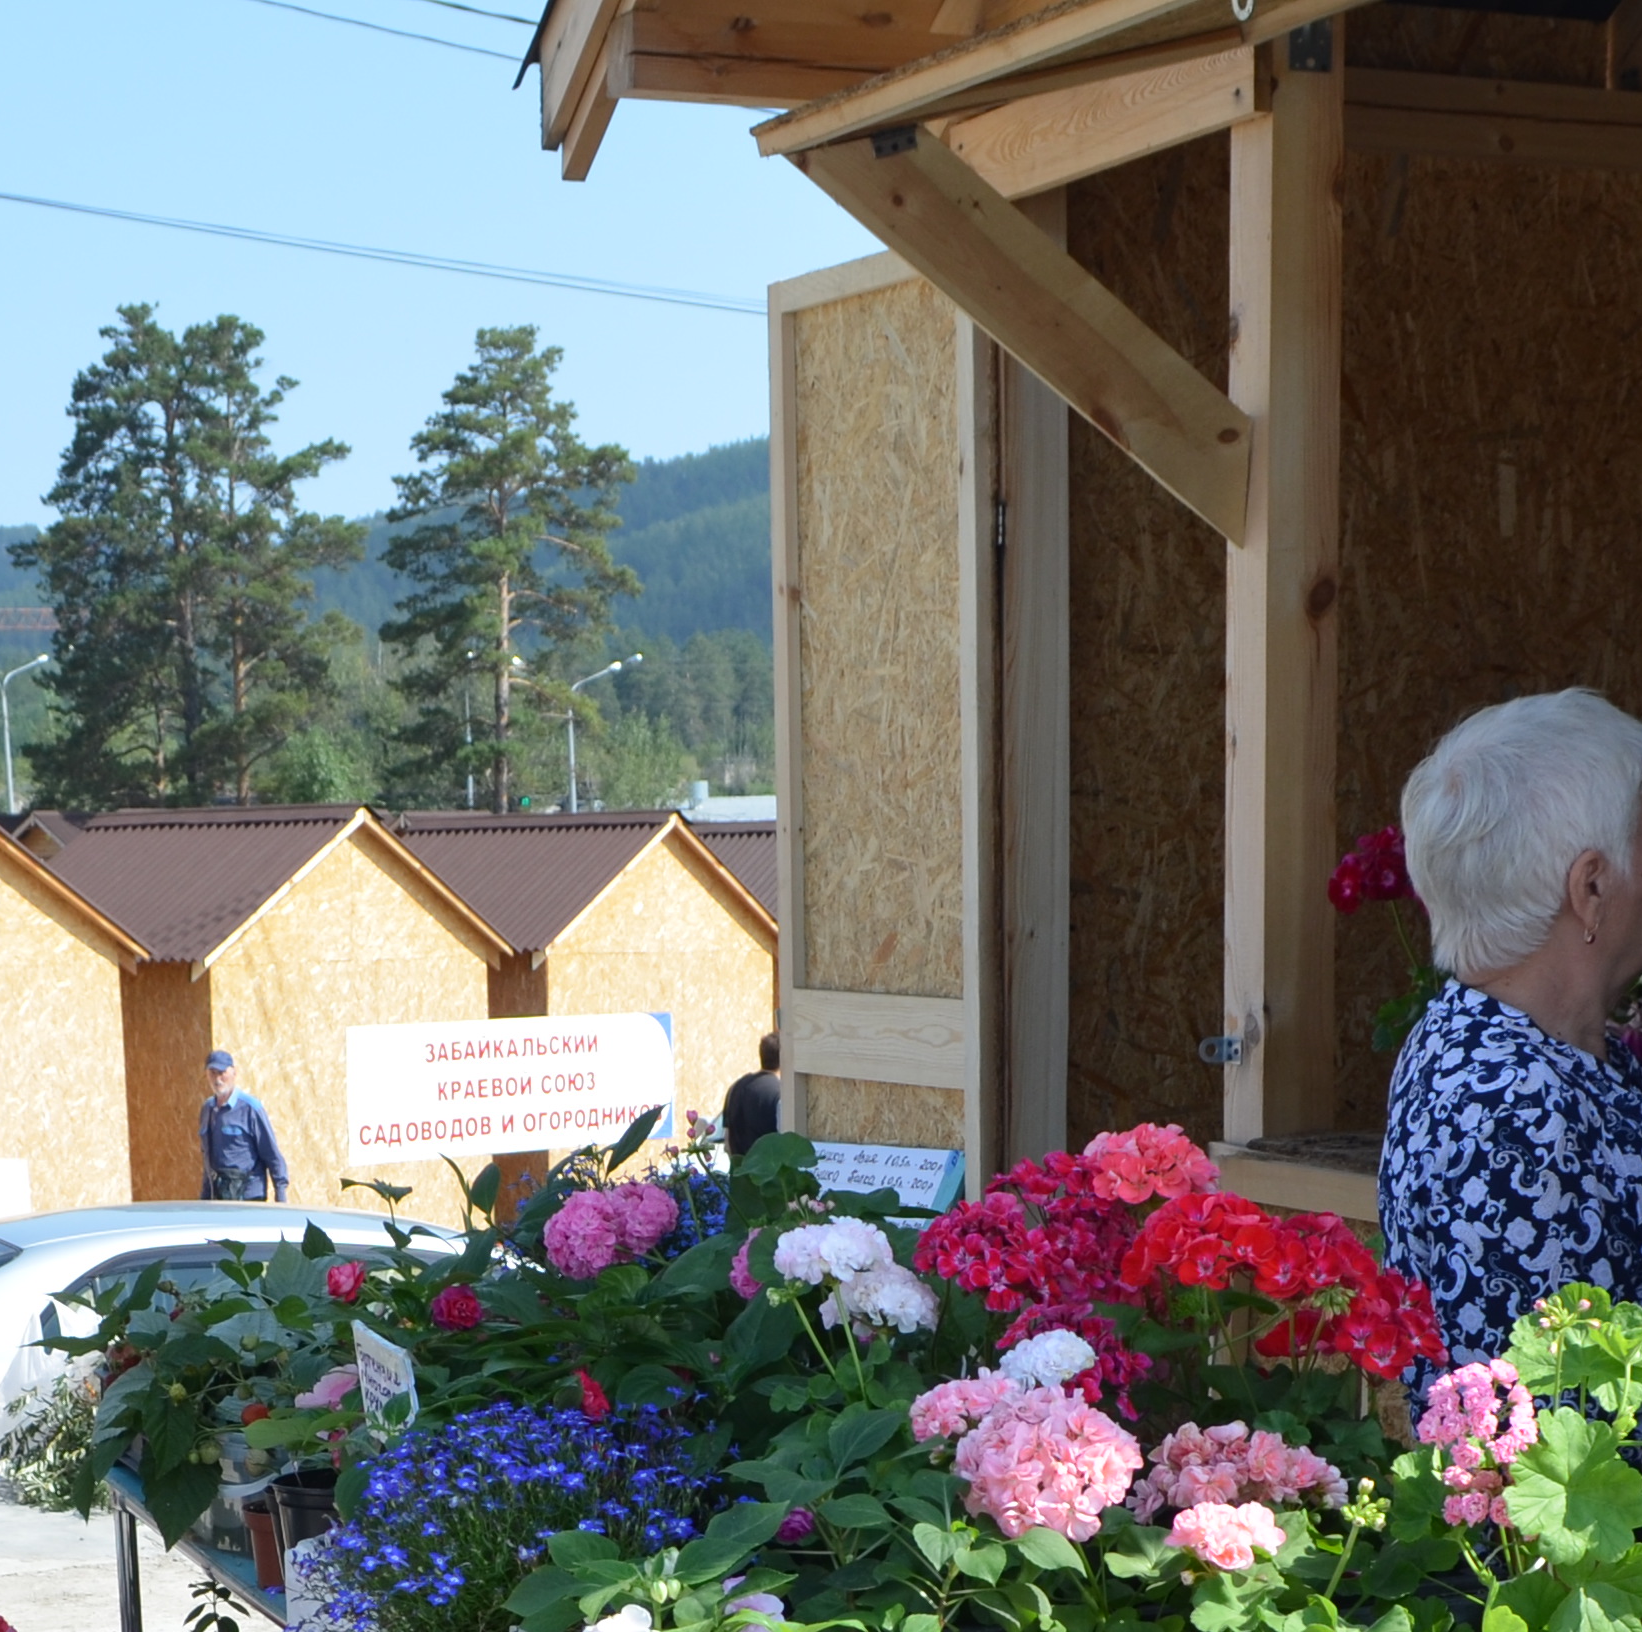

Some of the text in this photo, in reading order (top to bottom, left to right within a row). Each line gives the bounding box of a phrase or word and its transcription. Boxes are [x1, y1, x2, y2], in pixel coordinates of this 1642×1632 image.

[540, 1071, 596, 1095] СОЮЗ
[359, 1115, 492, 1148] САДОВОДОВ
[501, 1114, 515, 1134] И
